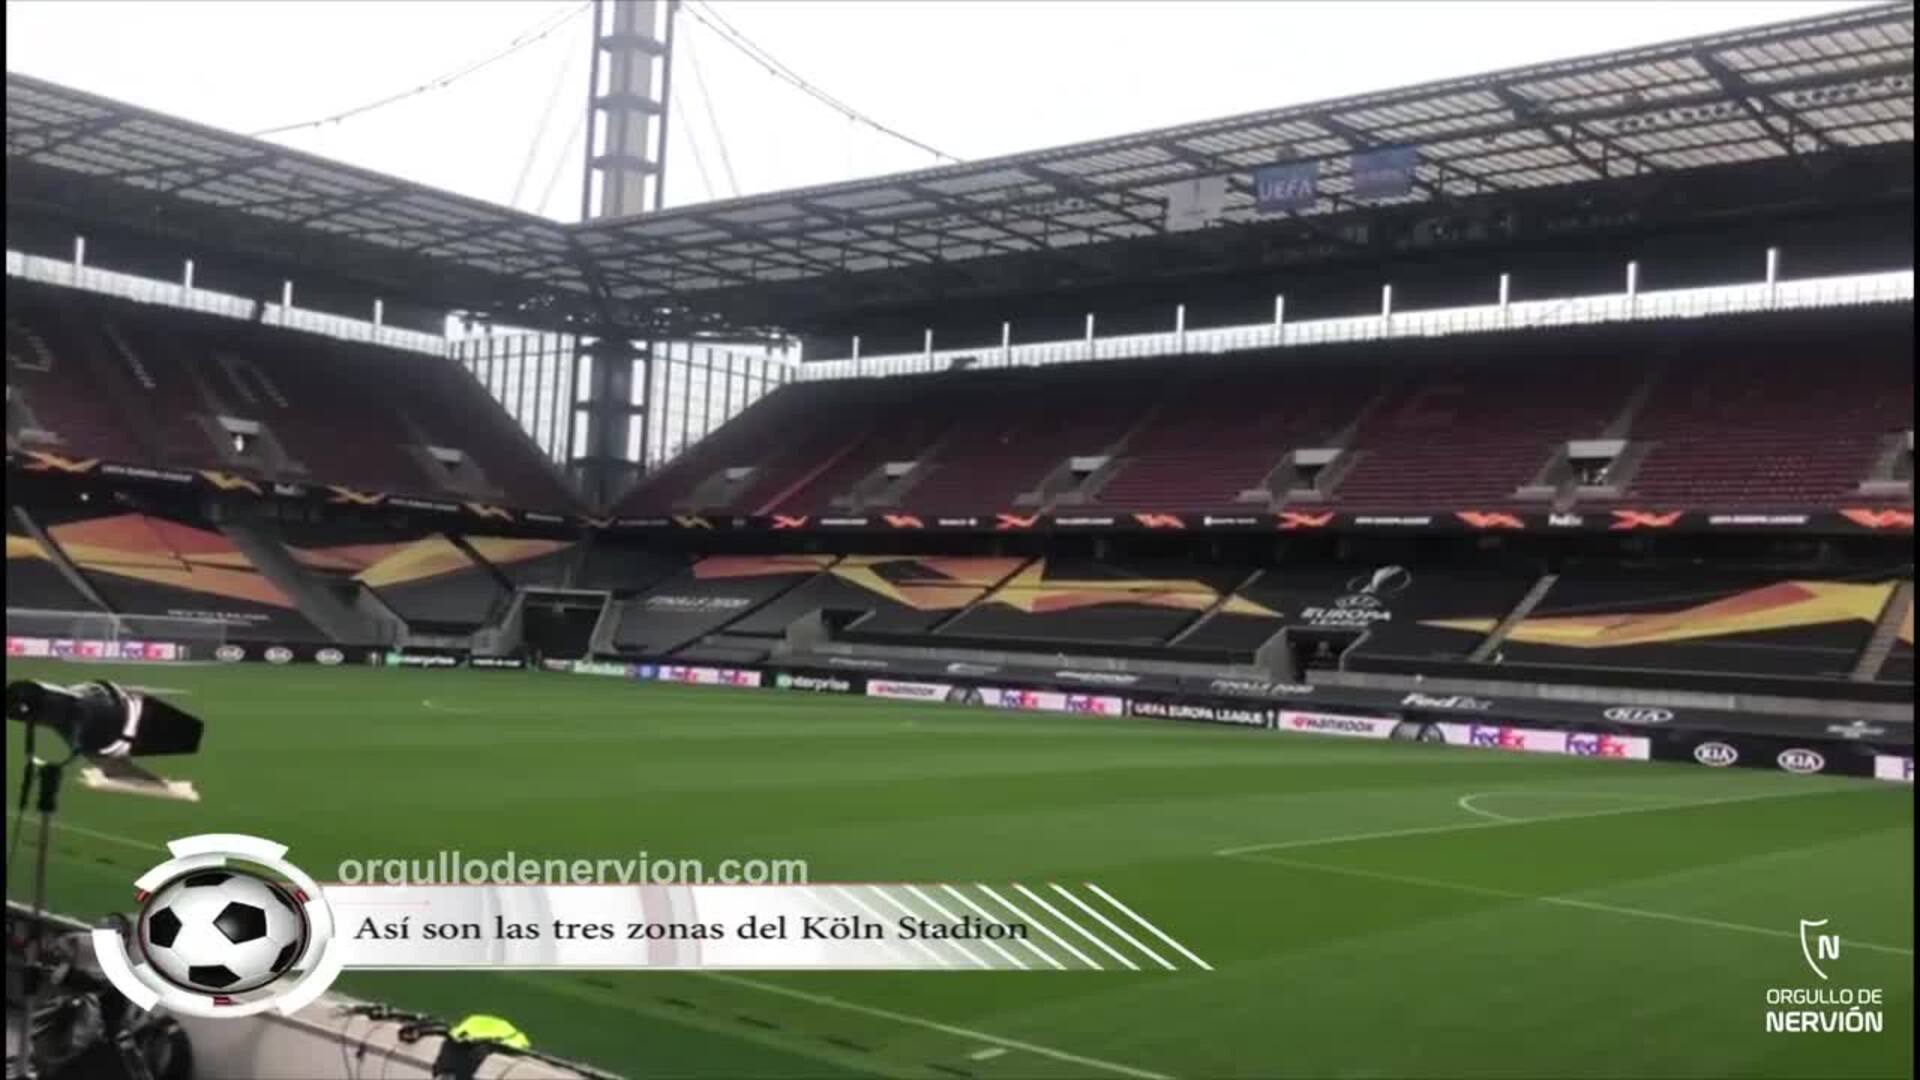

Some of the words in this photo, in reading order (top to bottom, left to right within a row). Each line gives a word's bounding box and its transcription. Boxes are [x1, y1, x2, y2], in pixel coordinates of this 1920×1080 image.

[1257, 177, 1314, 202] UEFA
[1301, 607, 1391, 622] EUROPA
[1134, 702, 1167, 716] UEFA
[1169, 704, 1213, 719] EUROPA
[1216, 709, 1263, 725] LEAGUE
[1469, 724, 1525, 748] FedEx
[1565, 733, 1628, 758] FedEx
